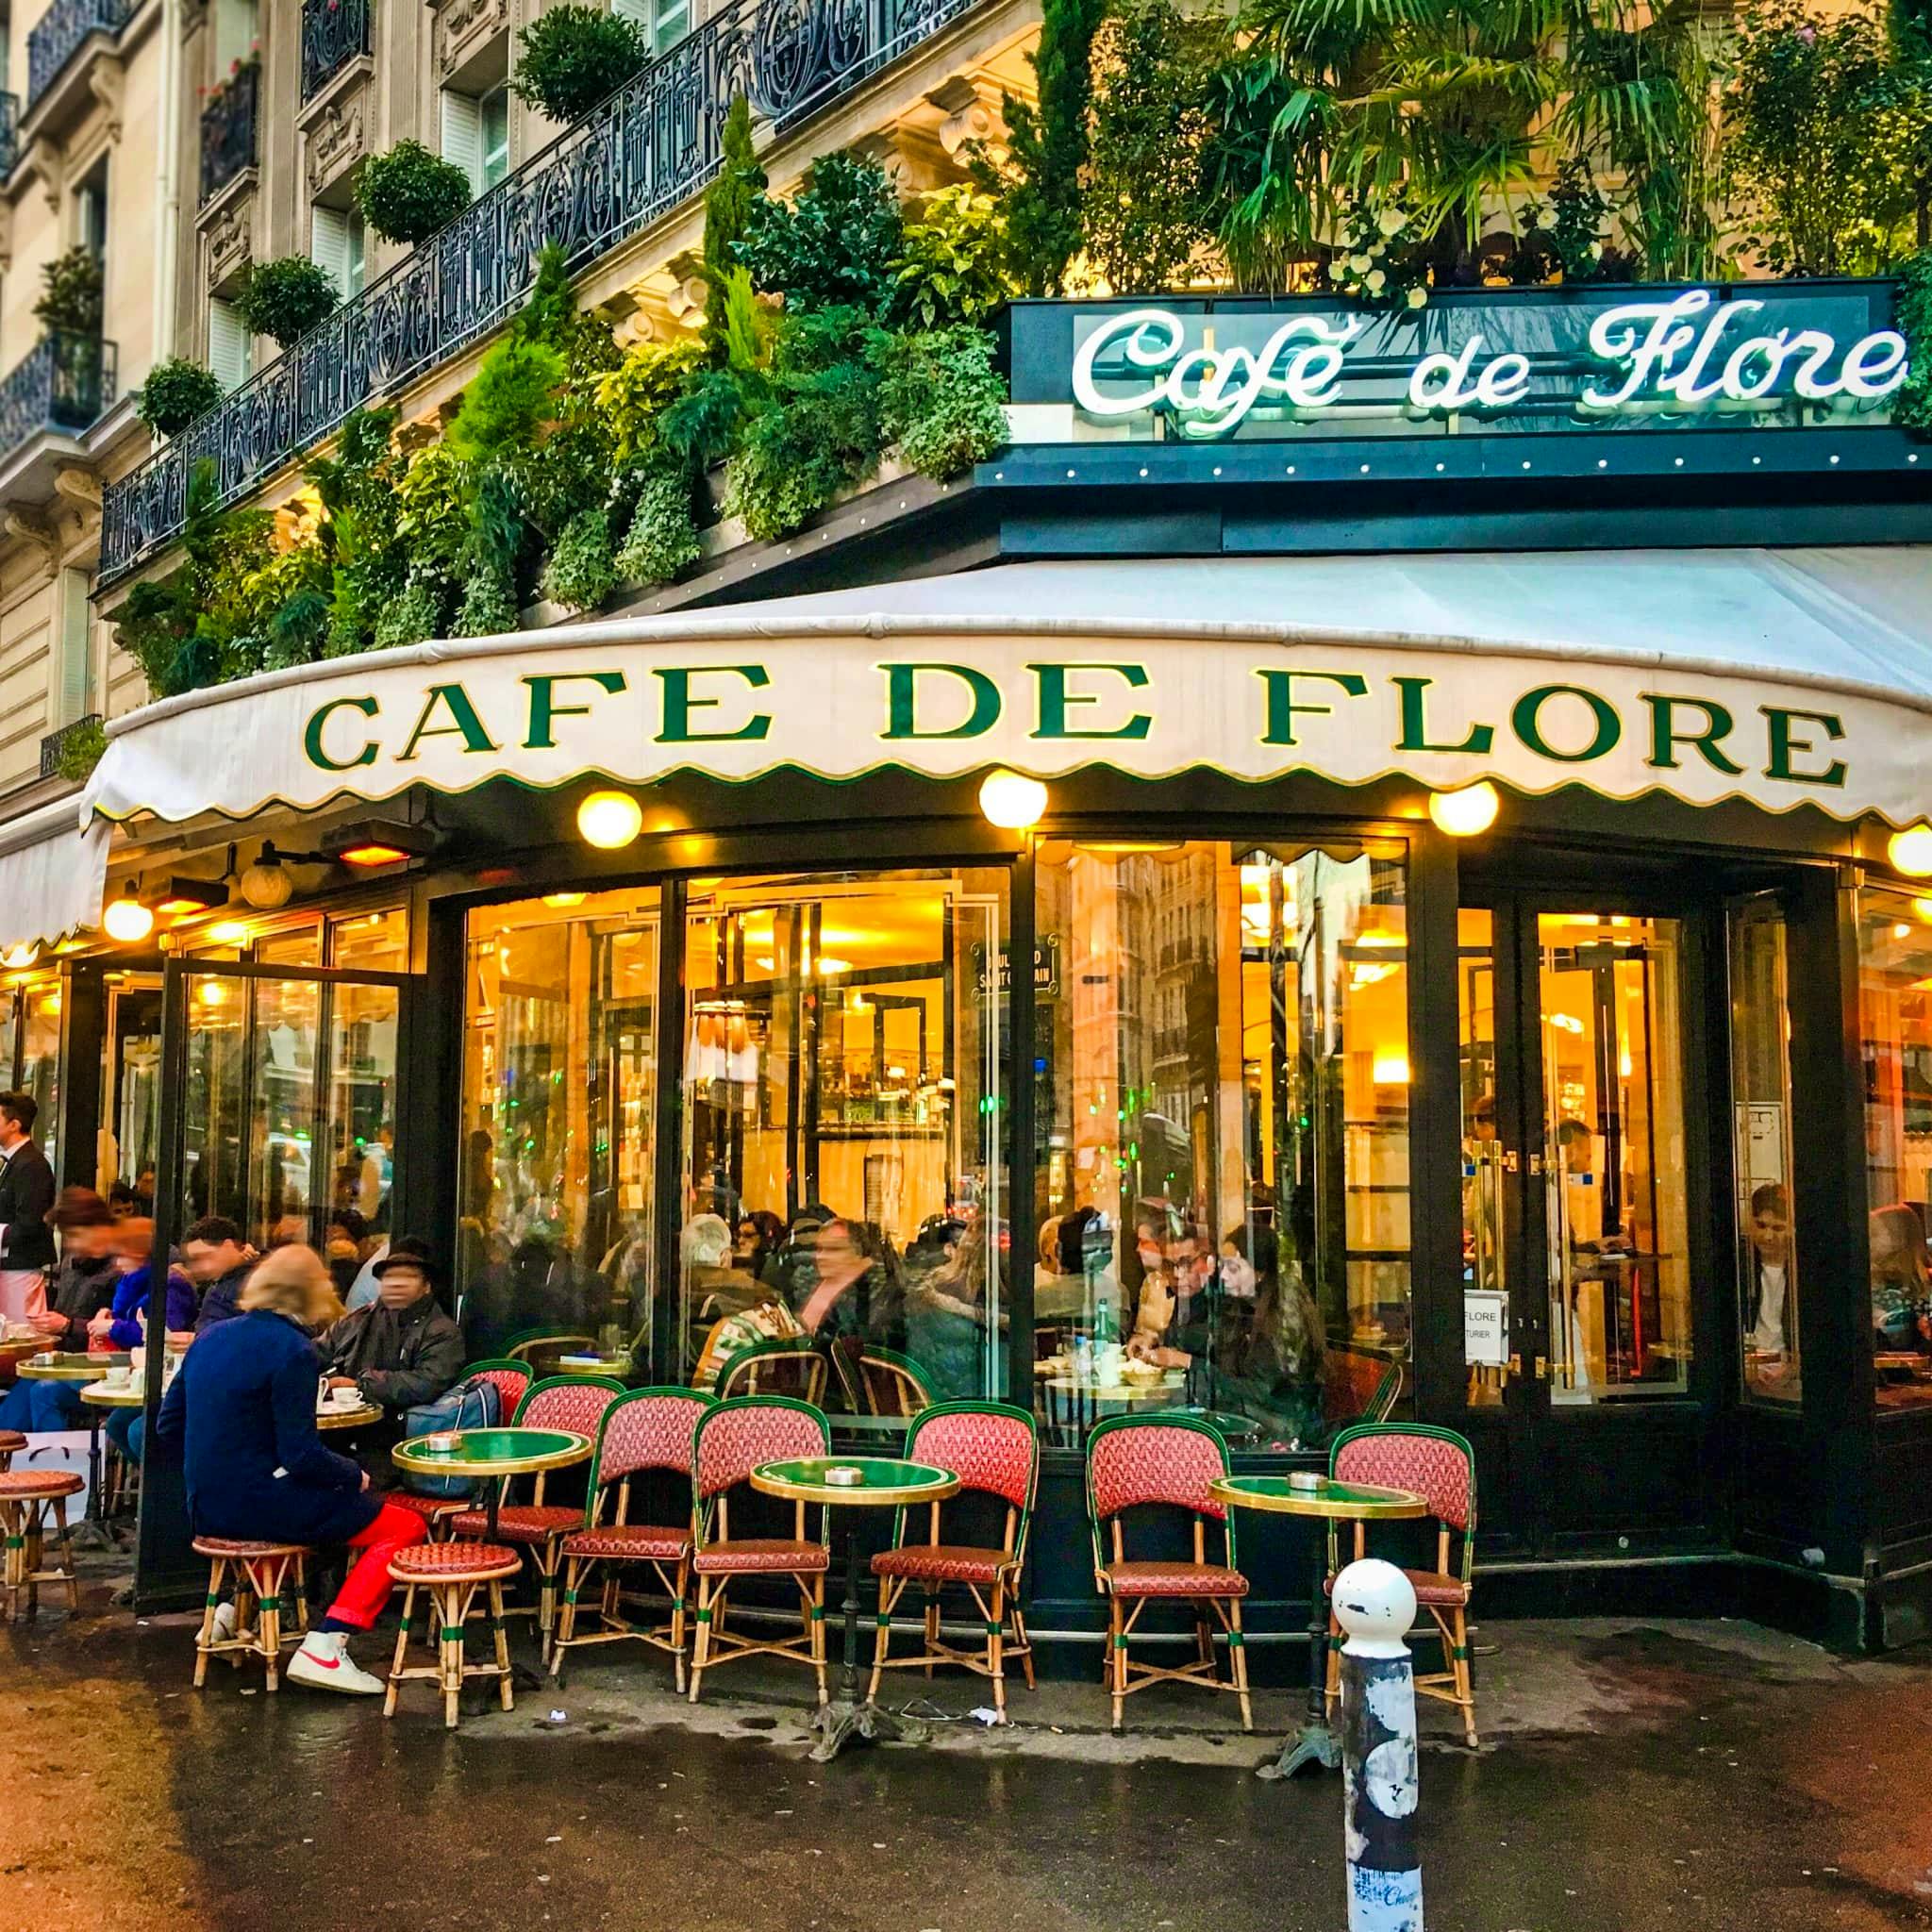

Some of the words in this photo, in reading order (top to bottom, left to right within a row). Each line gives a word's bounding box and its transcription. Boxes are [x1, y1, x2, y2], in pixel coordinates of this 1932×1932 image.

[1072, 308, 1364, 441] Café
[1409, 334, 1531, 410] de
[1582, 289, 1910, 411] Flore
[303, 663, 773, 772] CAFE
[875, 662, 1154, 741] DE
[1256, 668, 1849, 787] FLORE
